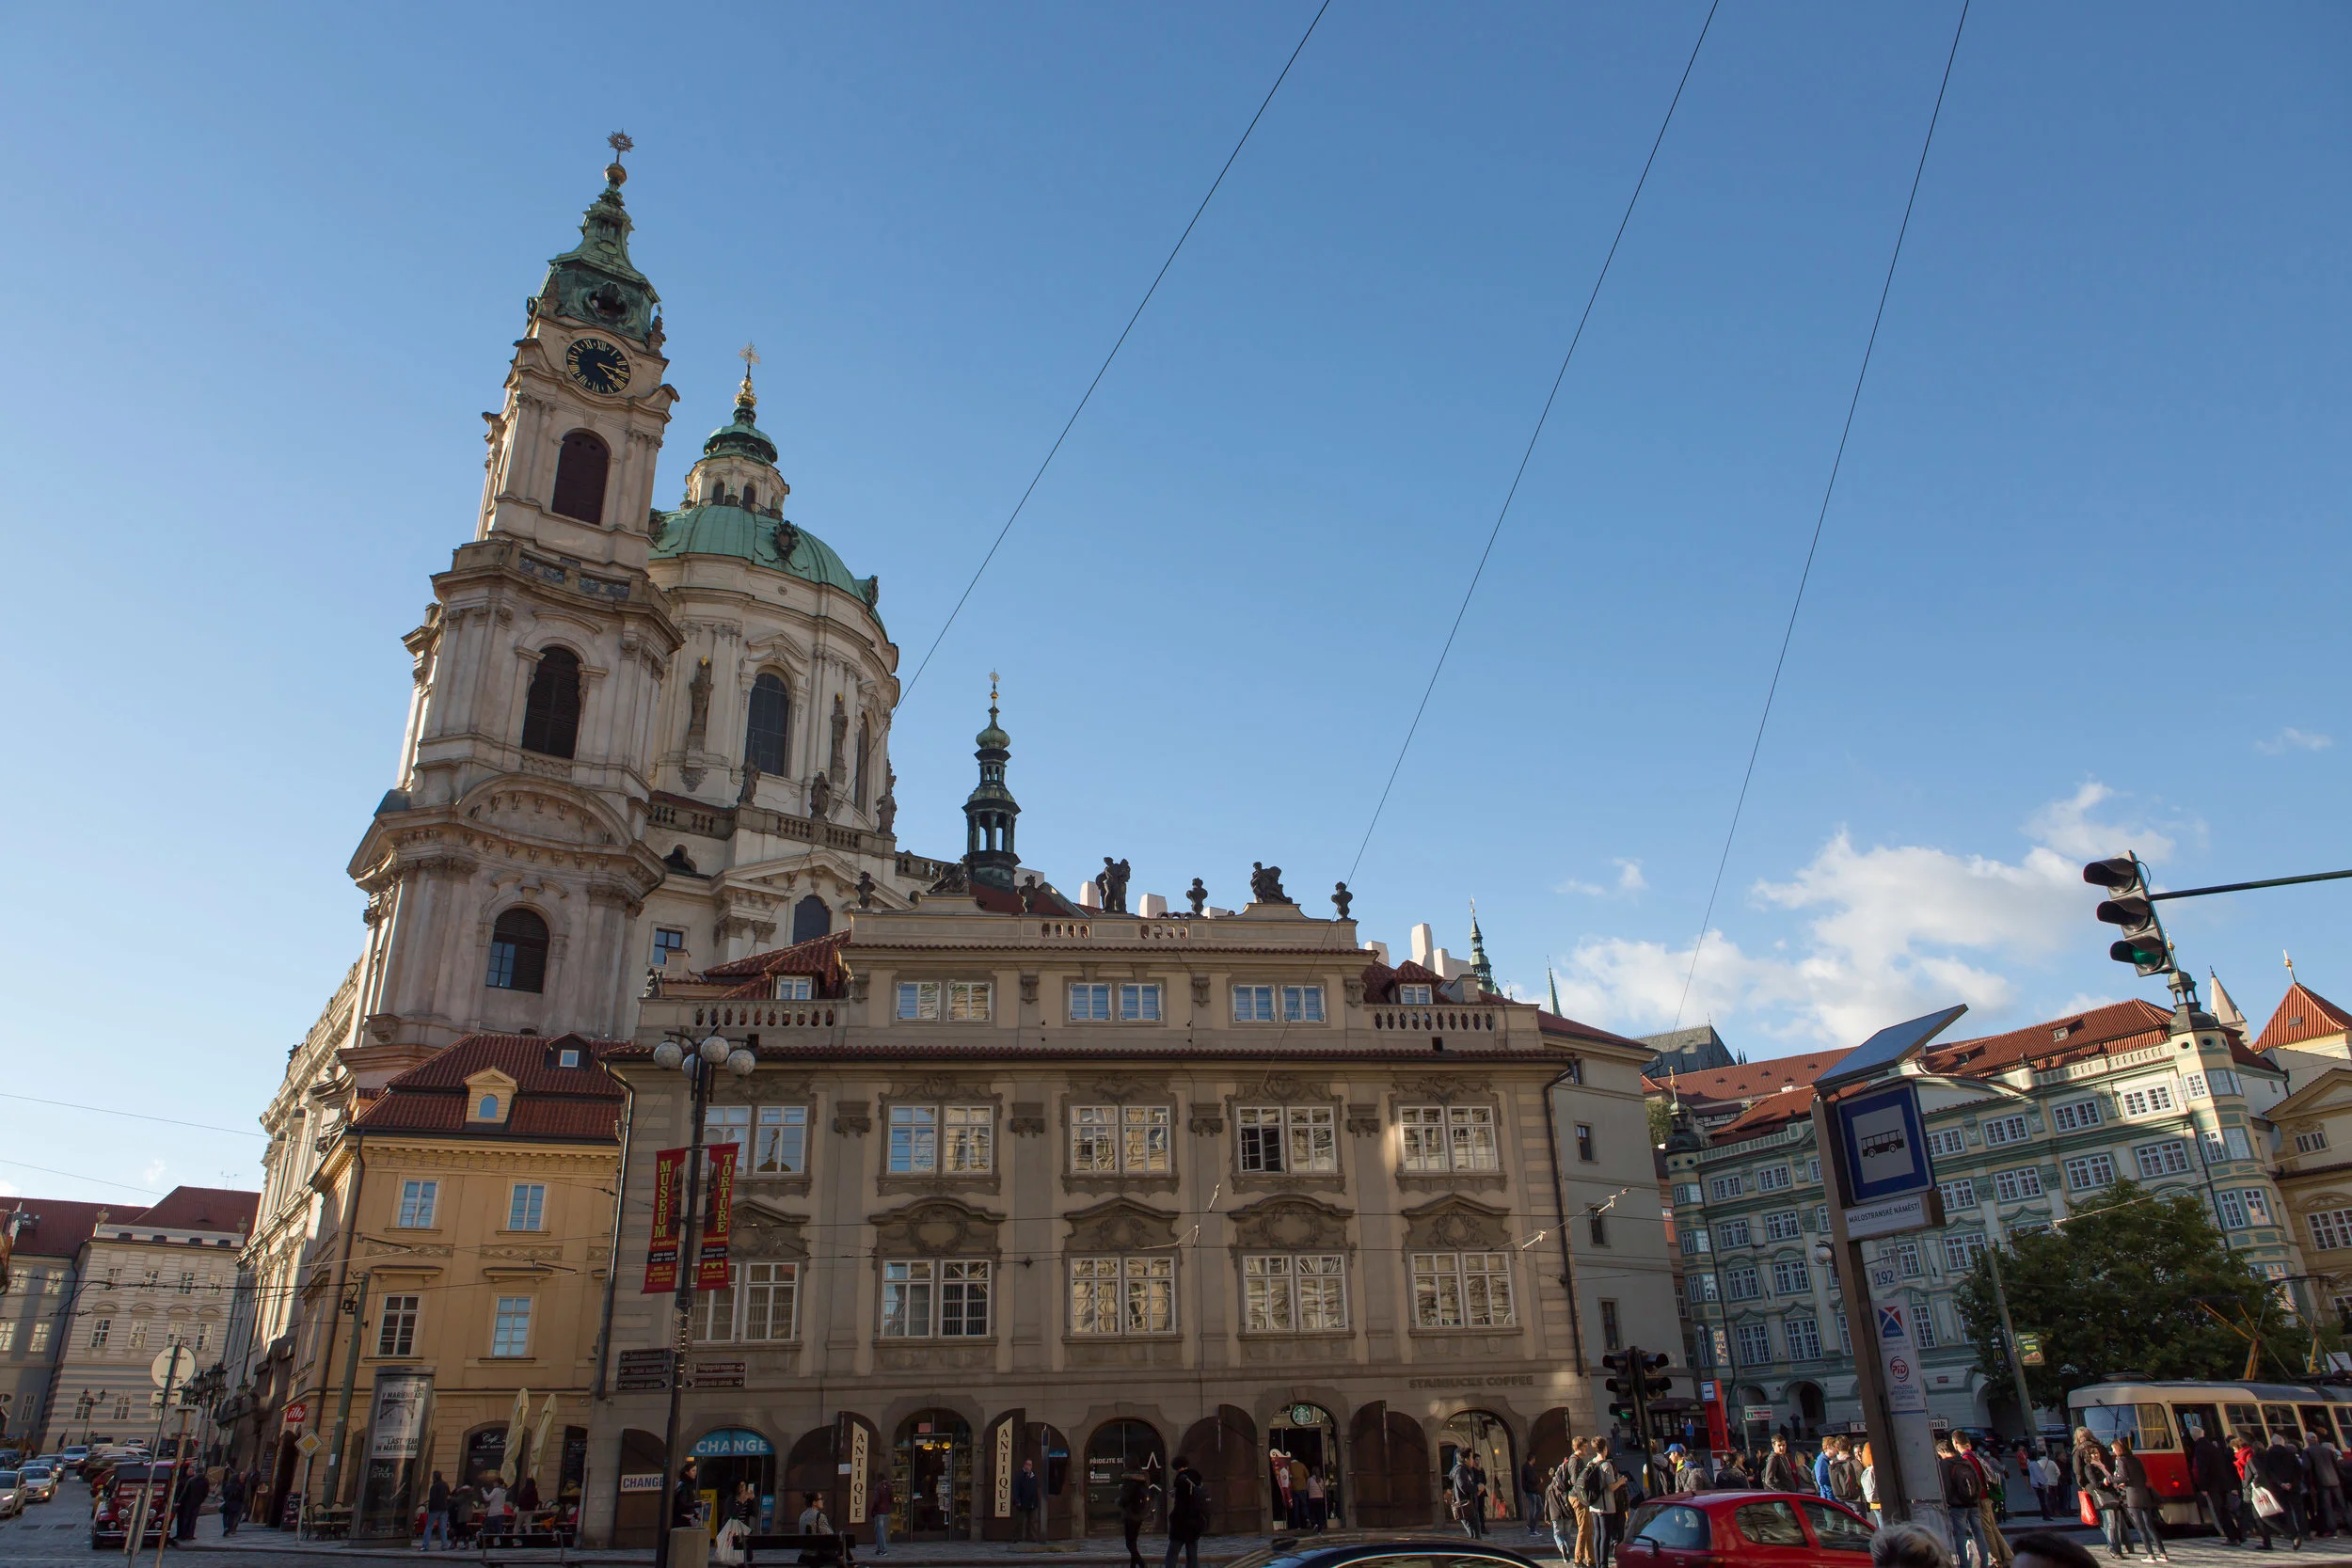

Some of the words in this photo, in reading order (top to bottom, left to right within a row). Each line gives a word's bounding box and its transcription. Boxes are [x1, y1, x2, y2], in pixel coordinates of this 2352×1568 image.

[654, 1160, 672, 1238] MUSEUM
[716, 1153, 734, 1233] TORTURE
[1848, 1207, 1894, 1223] MALOSTRANSKÉ
[1875, 1270, 1895, 1286] 192
[1408, 1376, 1484, 1389] STARBUCKS
[1486, 1375, 1534, 1386] COFFEE
[288, 1406, 305, 1420] illy
[695, 1439, 768, 1453] CHANGE
[853, 1433, 866, 1518] ANTIQUE
[998, 1428, 1009, 1513] ANTIQUE
[622, 1476, 664, 1489] CHANGE
